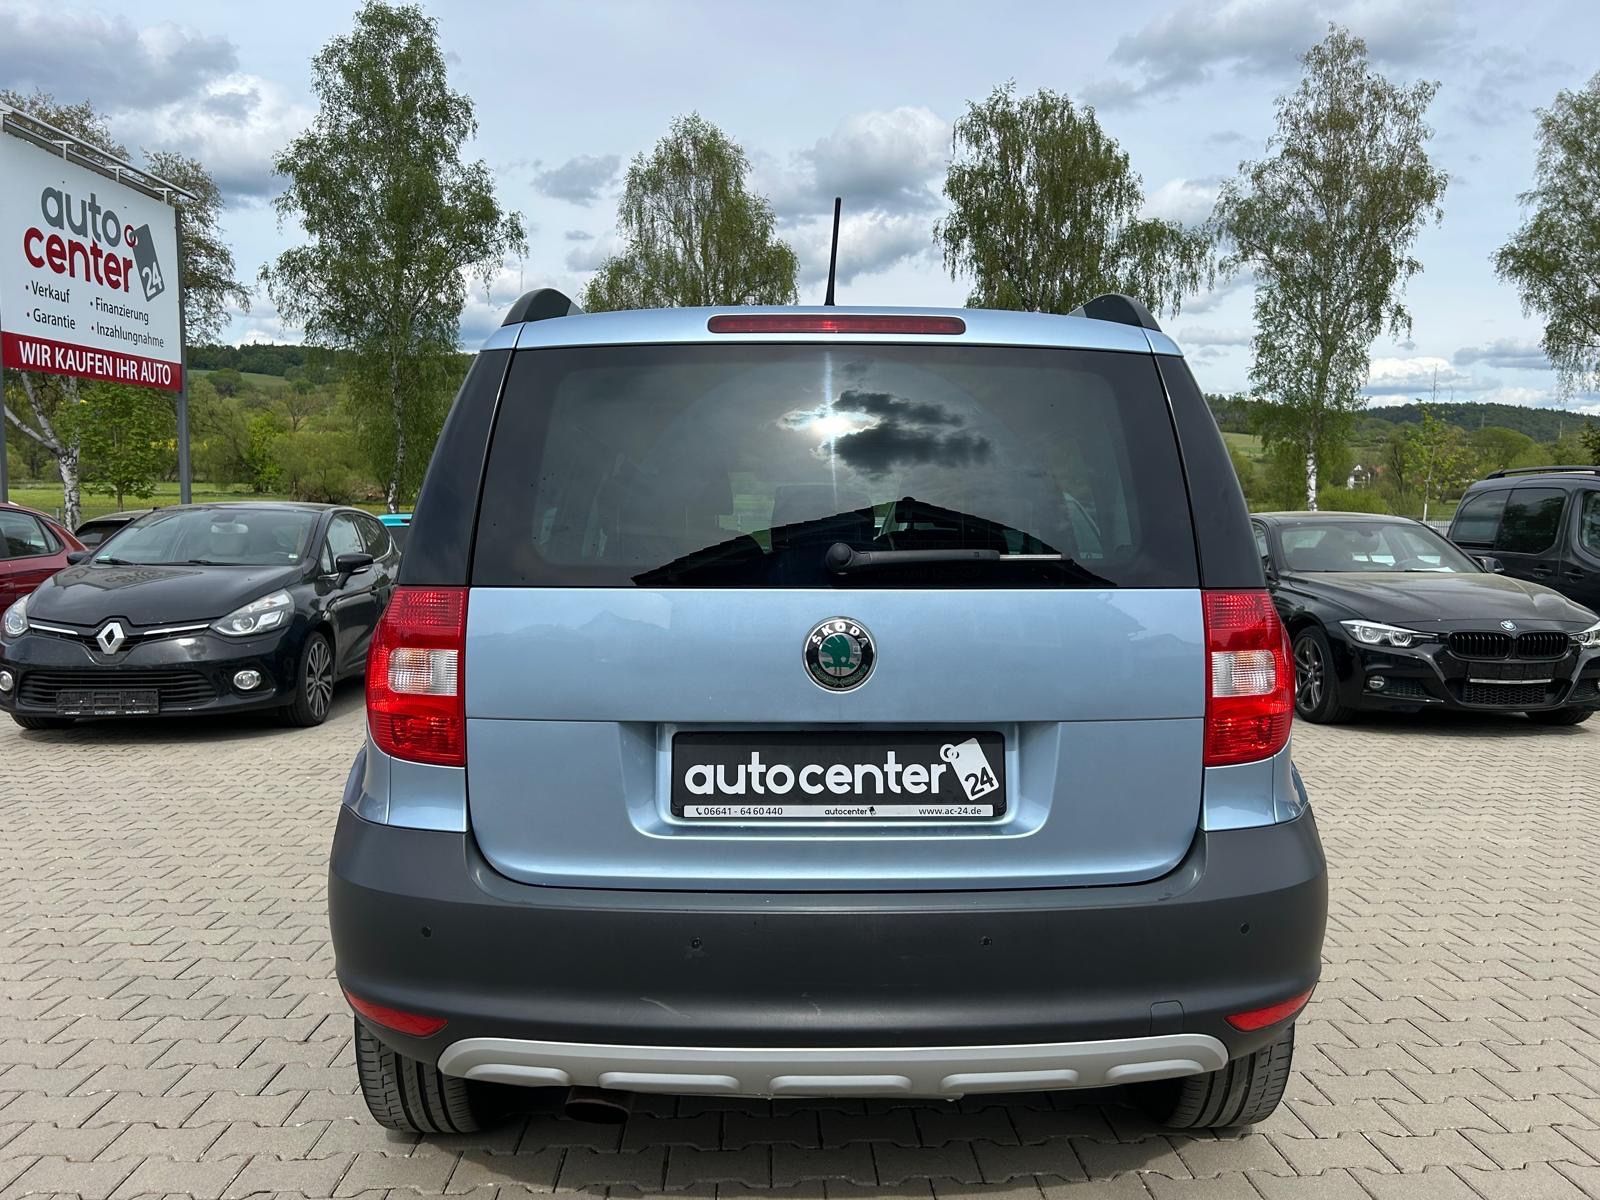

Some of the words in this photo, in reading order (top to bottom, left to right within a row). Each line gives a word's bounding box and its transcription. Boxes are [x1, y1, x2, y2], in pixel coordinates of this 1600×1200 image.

[41, 187, 121, 248] auto
[24, 227, 133, 292] center
[142, 261, 163, 297] 24
[31, 280, 70, 303] Verkauf
[33, 308, 76, 329] Garantie
[95, 297, 149, 325] Finanzierung
[96, 322, 164, 348] Inzahlungnahme
[19, 341, 51, 367] WIR
[55, 347, 113, 377] KAUFEN
[116, 358, 138, 381] IHR
[141, 360, 172, 385] AUTO
[964, 766, 995, 797] 24
[703, 807, 732, 816] 06641
[824, 807, 868, 816] autocenter
[918, 806, 982, 816] www.ac-24.de
